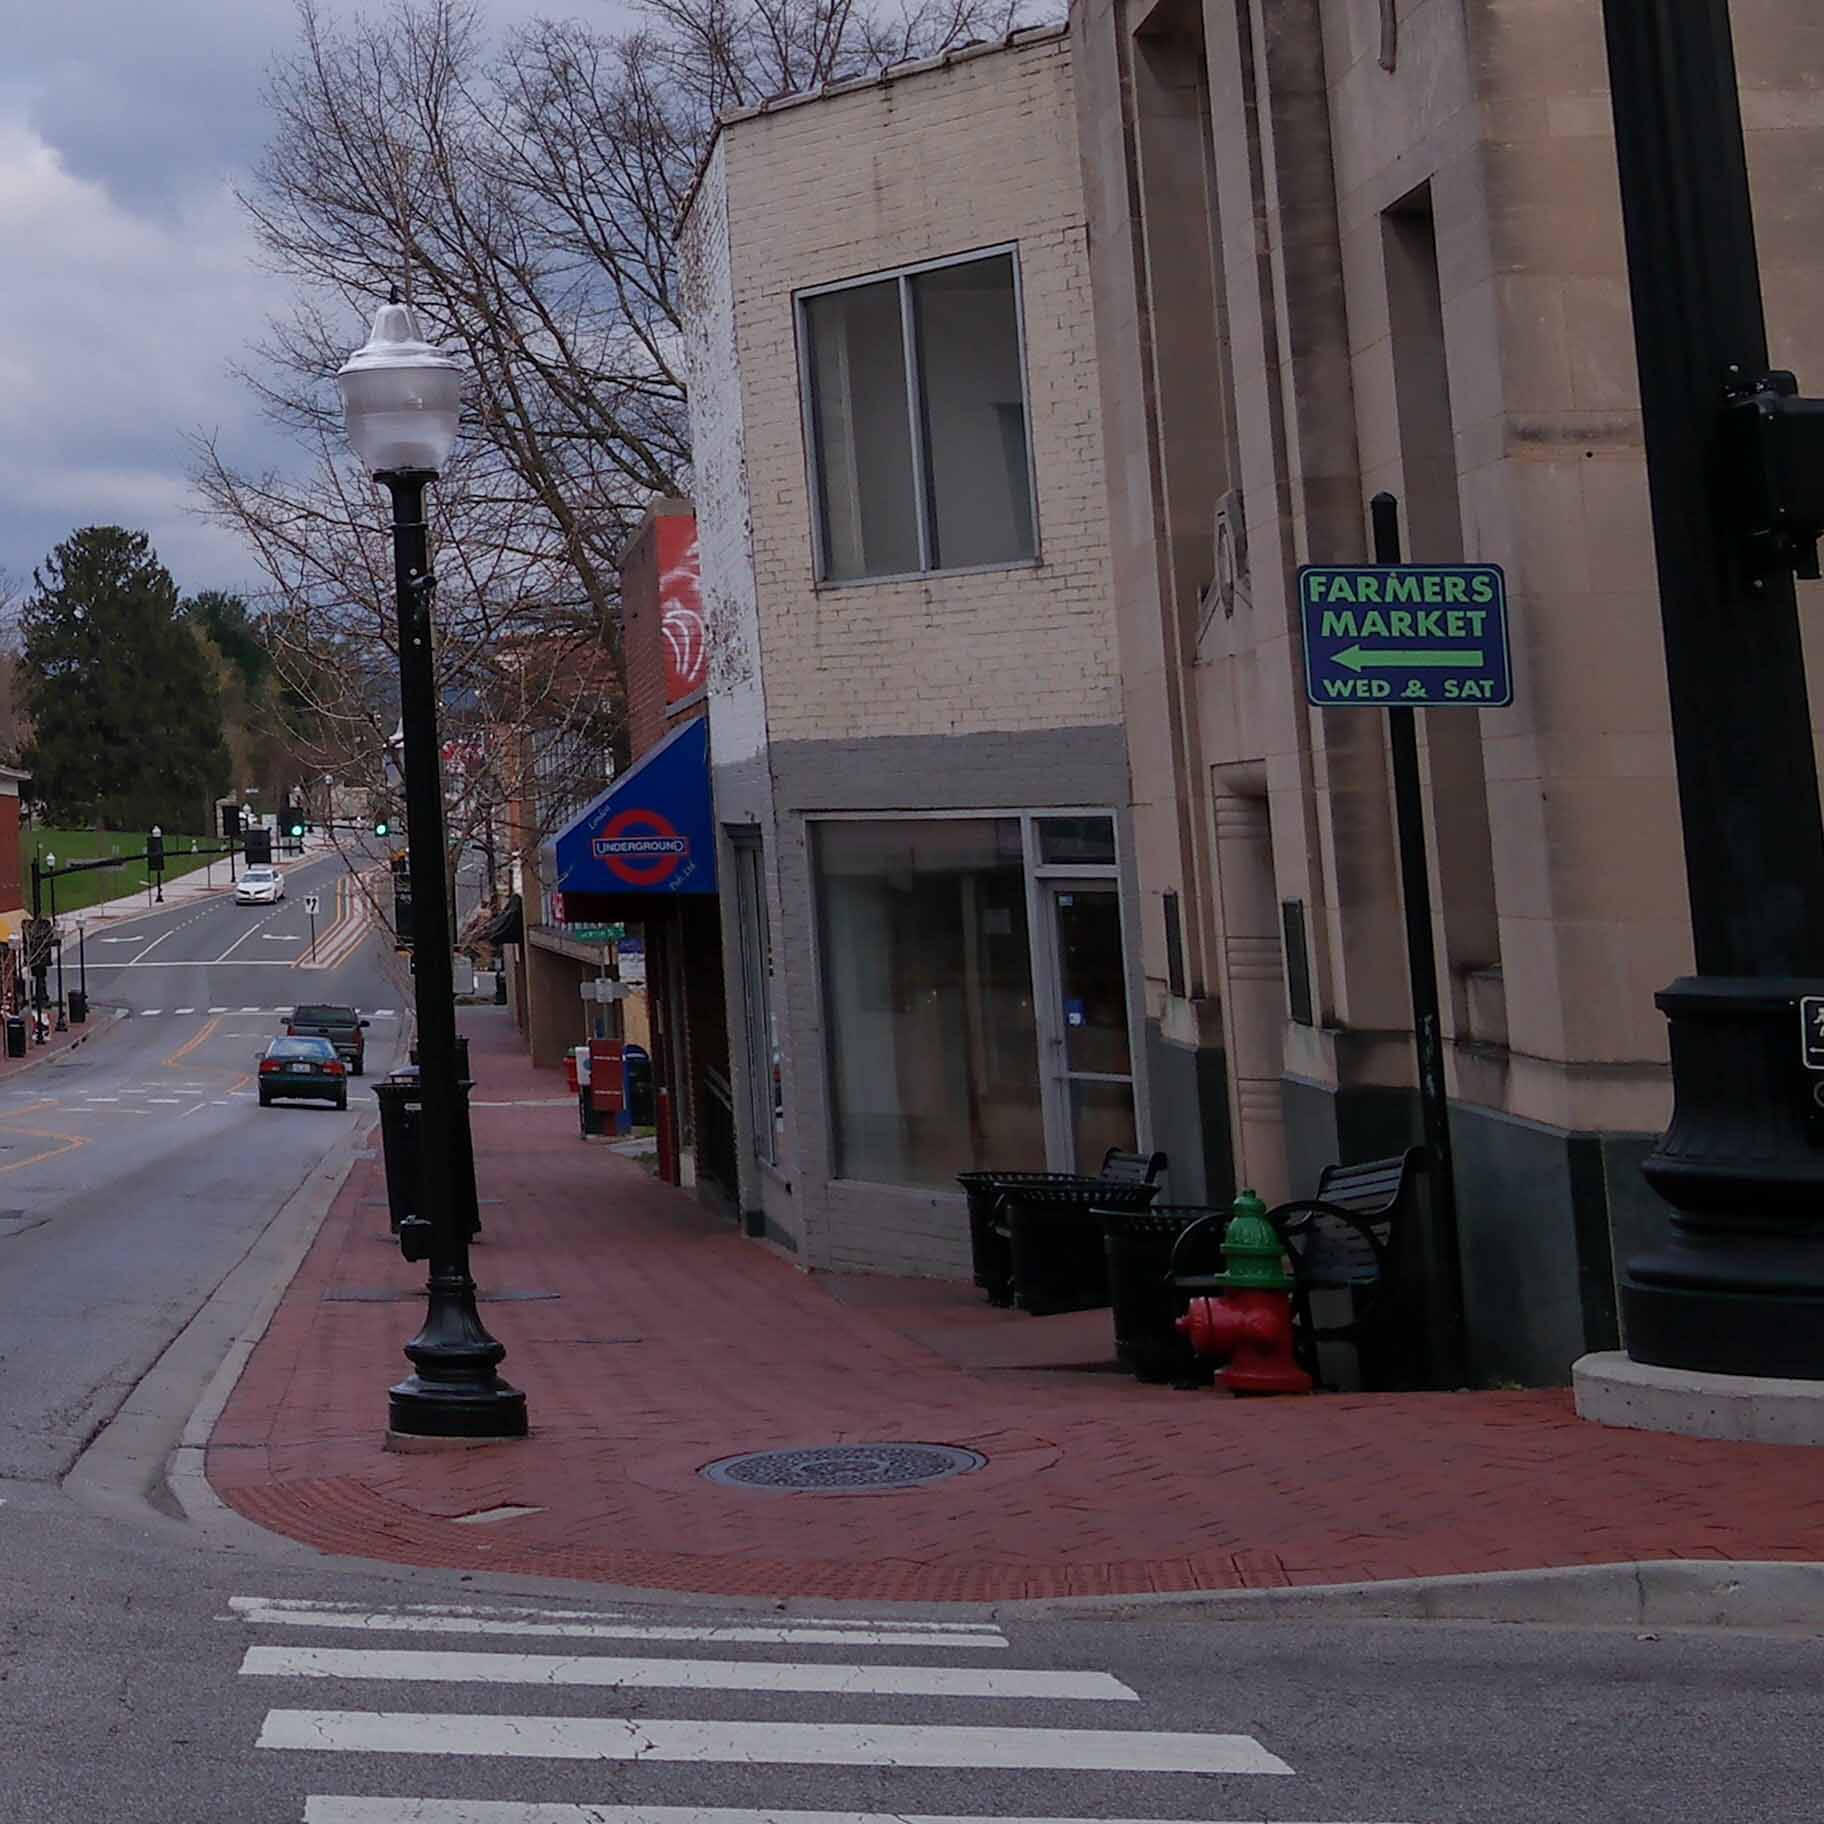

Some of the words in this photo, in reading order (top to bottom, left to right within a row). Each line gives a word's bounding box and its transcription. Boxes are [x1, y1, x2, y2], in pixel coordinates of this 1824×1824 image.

[1308, 575, 1494, 604] FARMERS
[1320, 609, 1487, 638] MARKET
[1322, 679, 1391, 698] WED
[1401, 679, 1429, 698] &
[1443, 679, 1495, 698] SAT
[595, 840, 684, 854] UNDERGROUND
